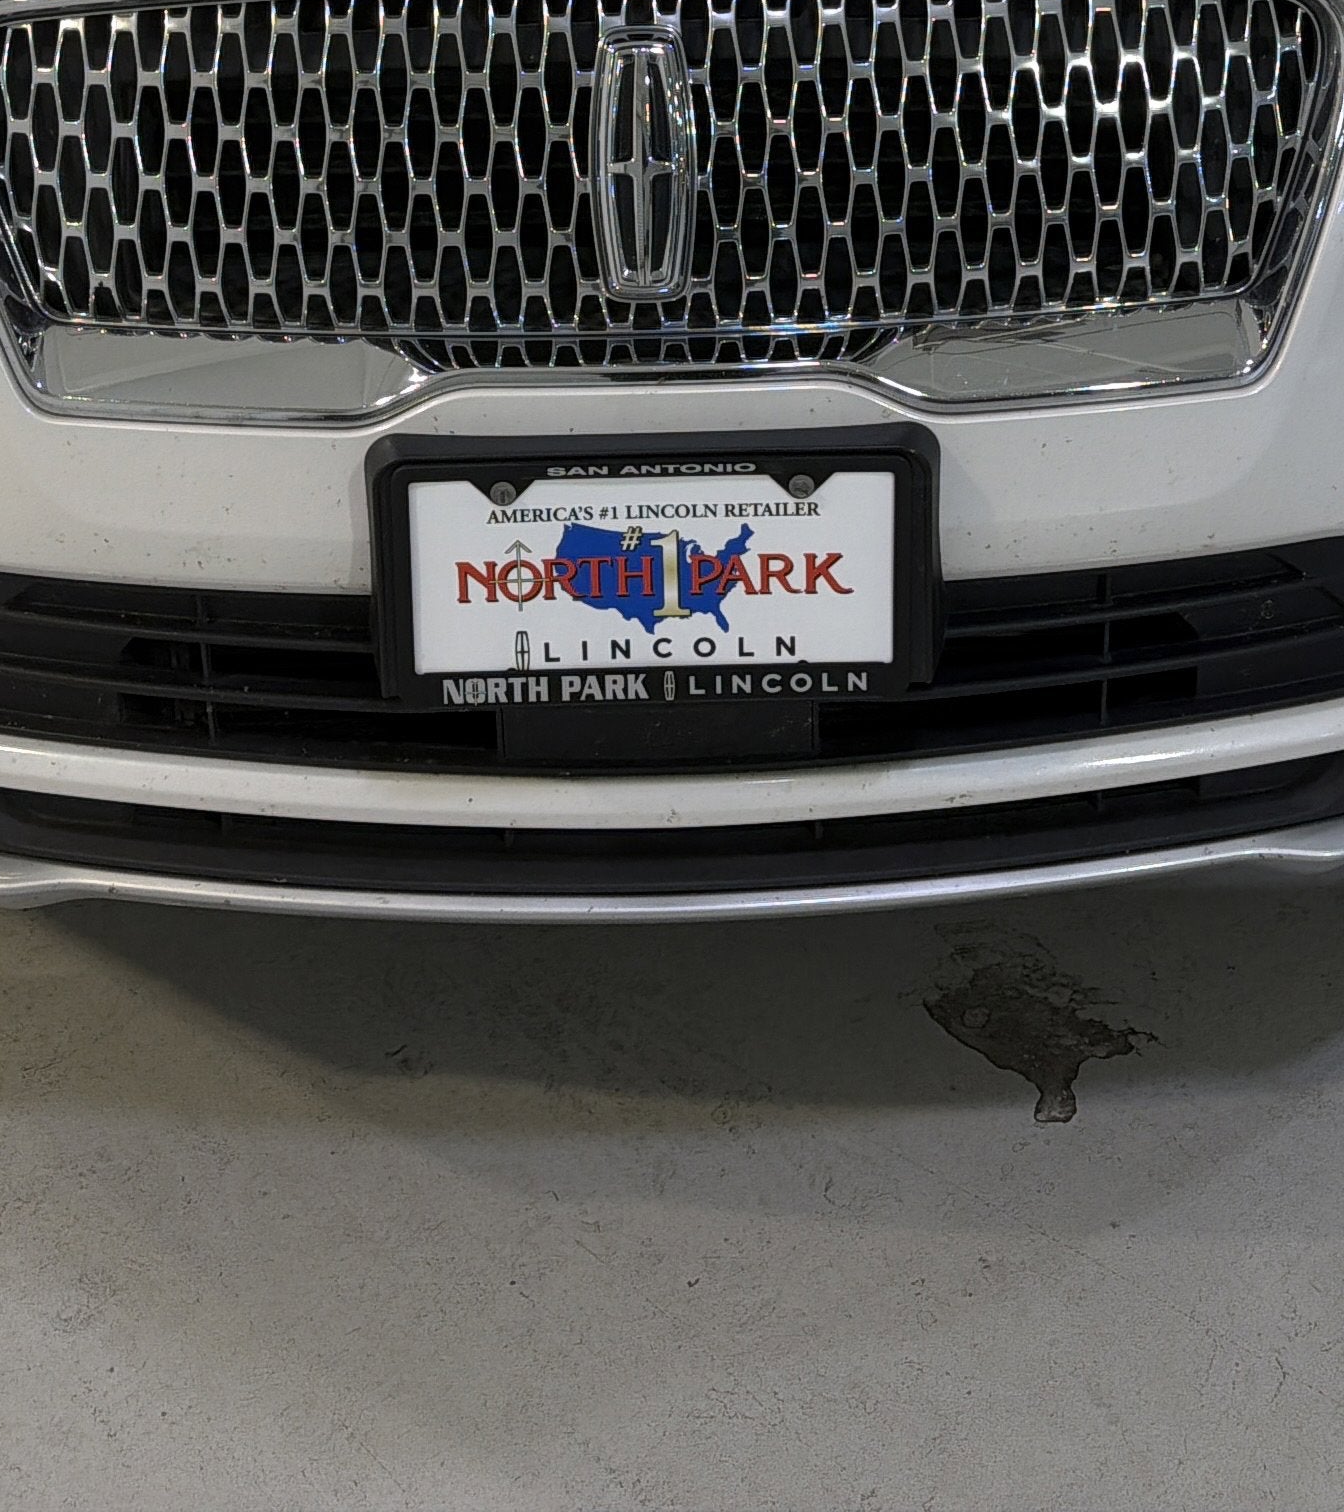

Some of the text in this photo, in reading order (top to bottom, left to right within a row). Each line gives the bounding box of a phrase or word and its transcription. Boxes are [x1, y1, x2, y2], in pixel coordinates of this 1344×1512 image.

[546, 462, 757, 477] SAN ANTONIO
[486, 501, 821, 525] AMERICA'S #1 LINCOLN RETAILER
[455, 552, 855, 604] NORTH PARK
[543, 635, 797, 663] LINCOLN
[442, 671, 868, 706] NORTH PARK LINCOLN
